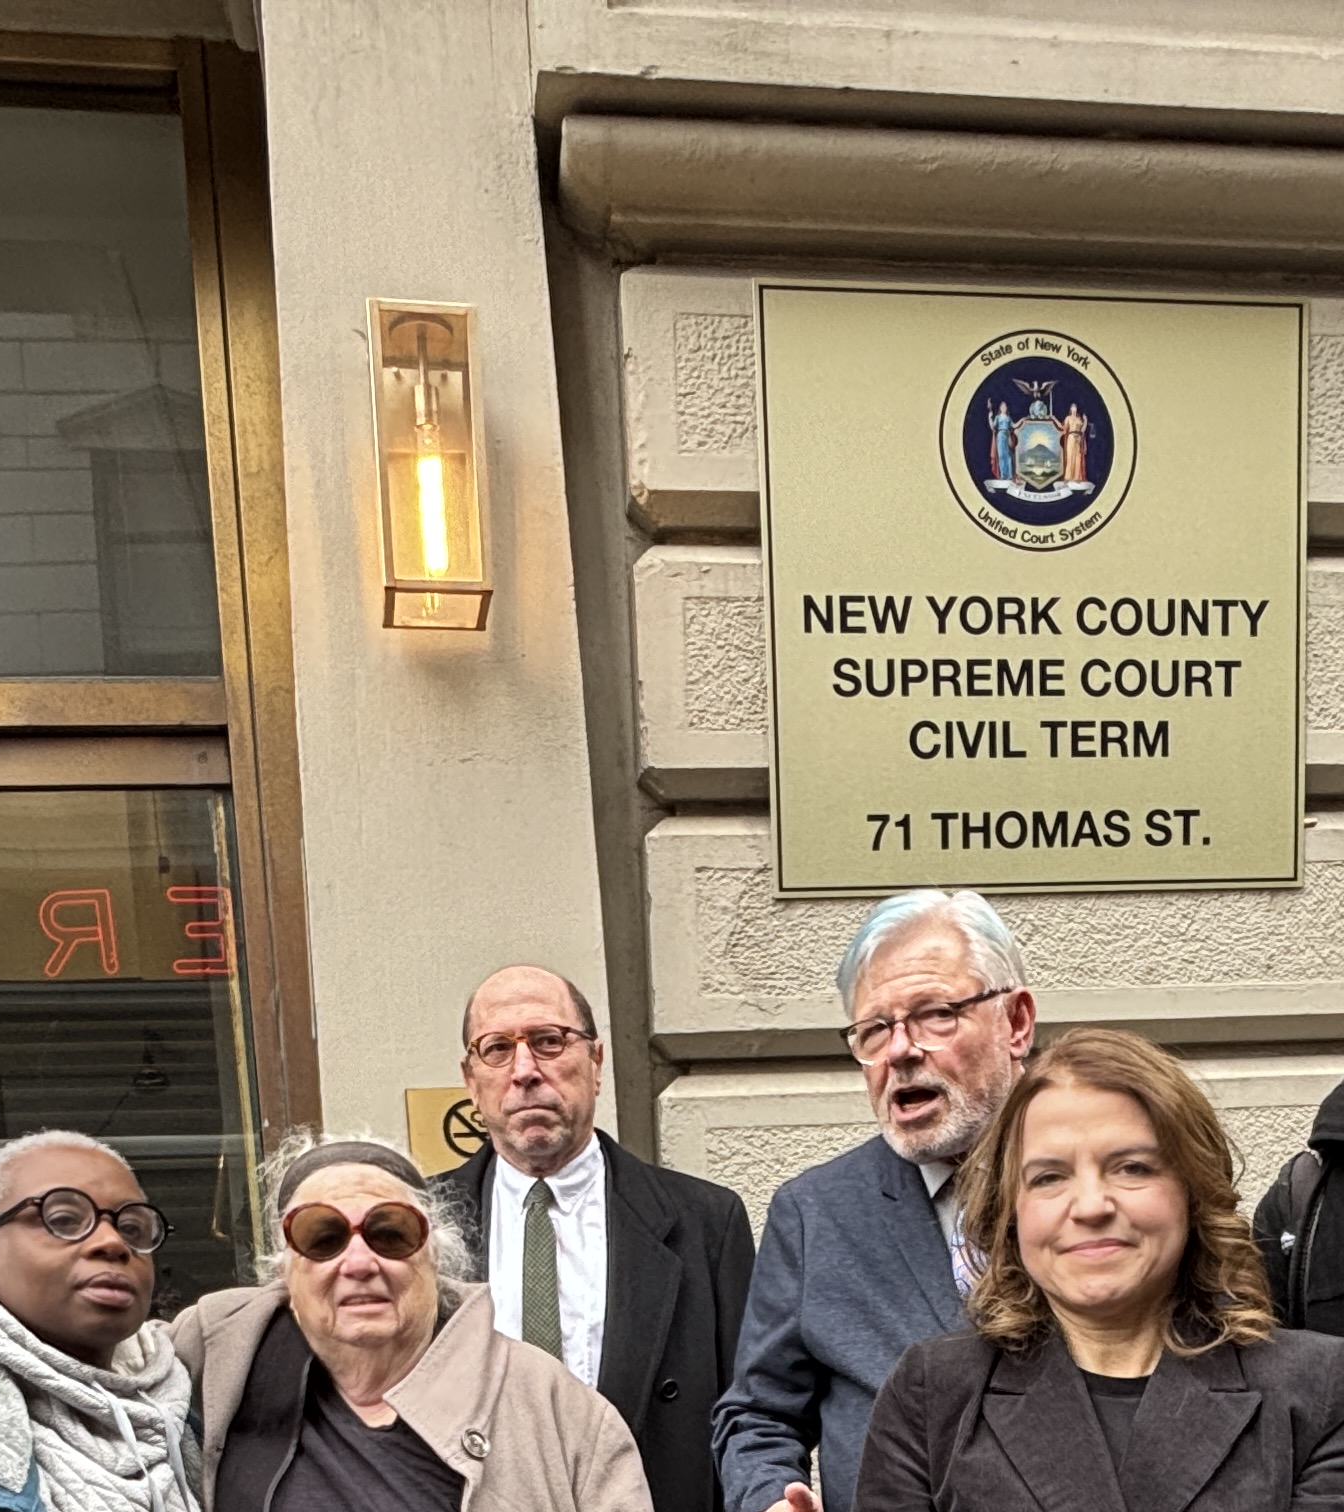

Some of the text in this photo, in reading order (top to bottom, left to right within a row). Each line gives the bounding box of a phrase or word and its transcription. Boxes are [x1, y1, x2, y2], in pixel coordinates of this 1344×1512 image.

[980, 337, 1090, 371] State of New York
[977, 506, 1103, 544] Unified Court System
[803, 594, 1270, 637] NEW YORK COUNTY
[832, 657, 1242, 698] SUPREME COURT
[909, 720, 1169, 760] CIVIL TERM
[866, 808, 1211, 851] 71 THOMAS ST.
